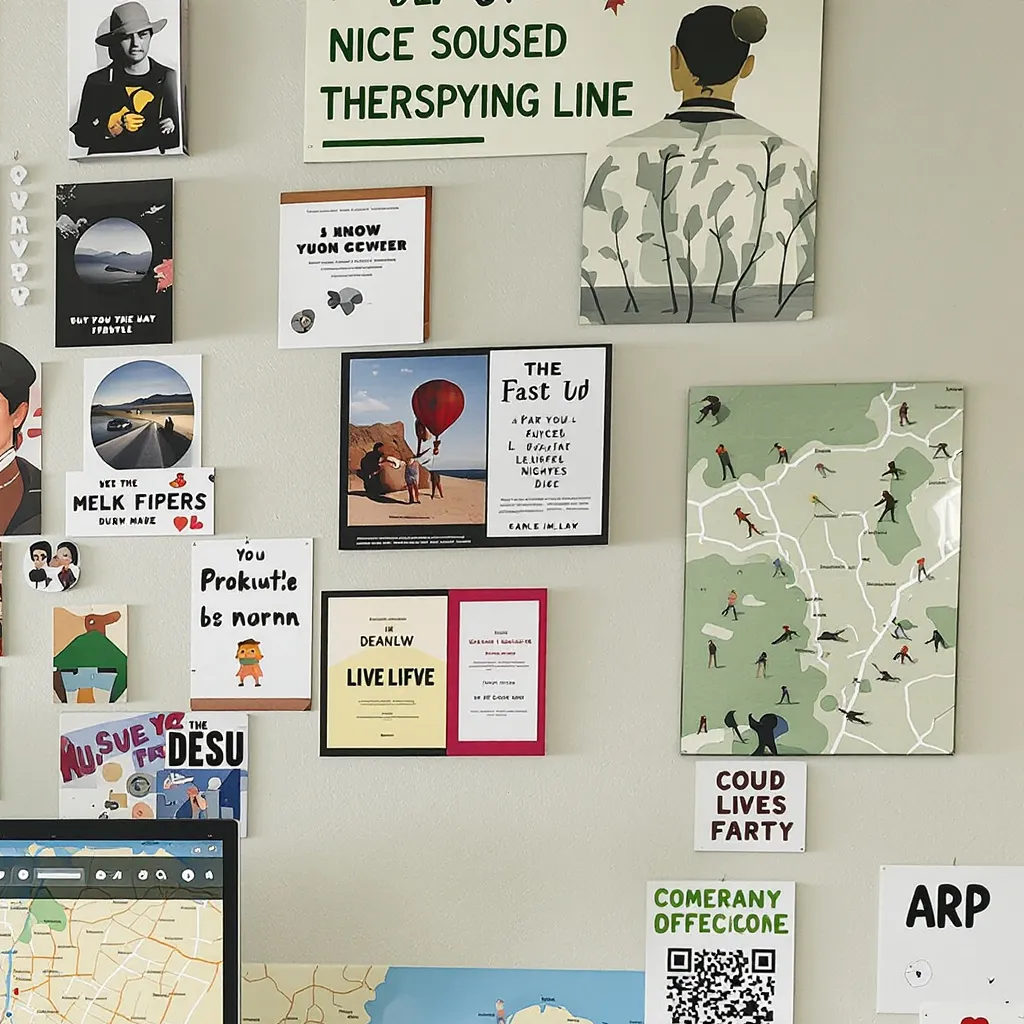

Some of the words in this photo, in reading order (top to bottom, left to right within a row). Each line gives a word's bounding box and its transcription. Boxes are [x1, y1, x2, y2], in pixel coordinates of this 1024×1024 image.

[329, 26, 414, 62] NICE
[431, 23, 568, 60] SOUSED
[320, 82, 540, 120] THERSPYING
[554, 81, 634, 117] LINE
[524, 362, 562, 376] THE
[501, 379, 551, 403] Fast
[74, 494, 125, 511] MELK
[135, 493, 207, 511] FIPERS
[347, 668, 384, 687] LIVE
[189, 720, 208, 730] THE
[168, 731, 244, 767] DESU
[716, 770, 786, 791] COUD
[717, 796, 787, 815] LIVES
[711, 821, 794, 841] FARTY
[654, 888, 781, 909] COMERANY
[906, 884, 991, 929] ARP
